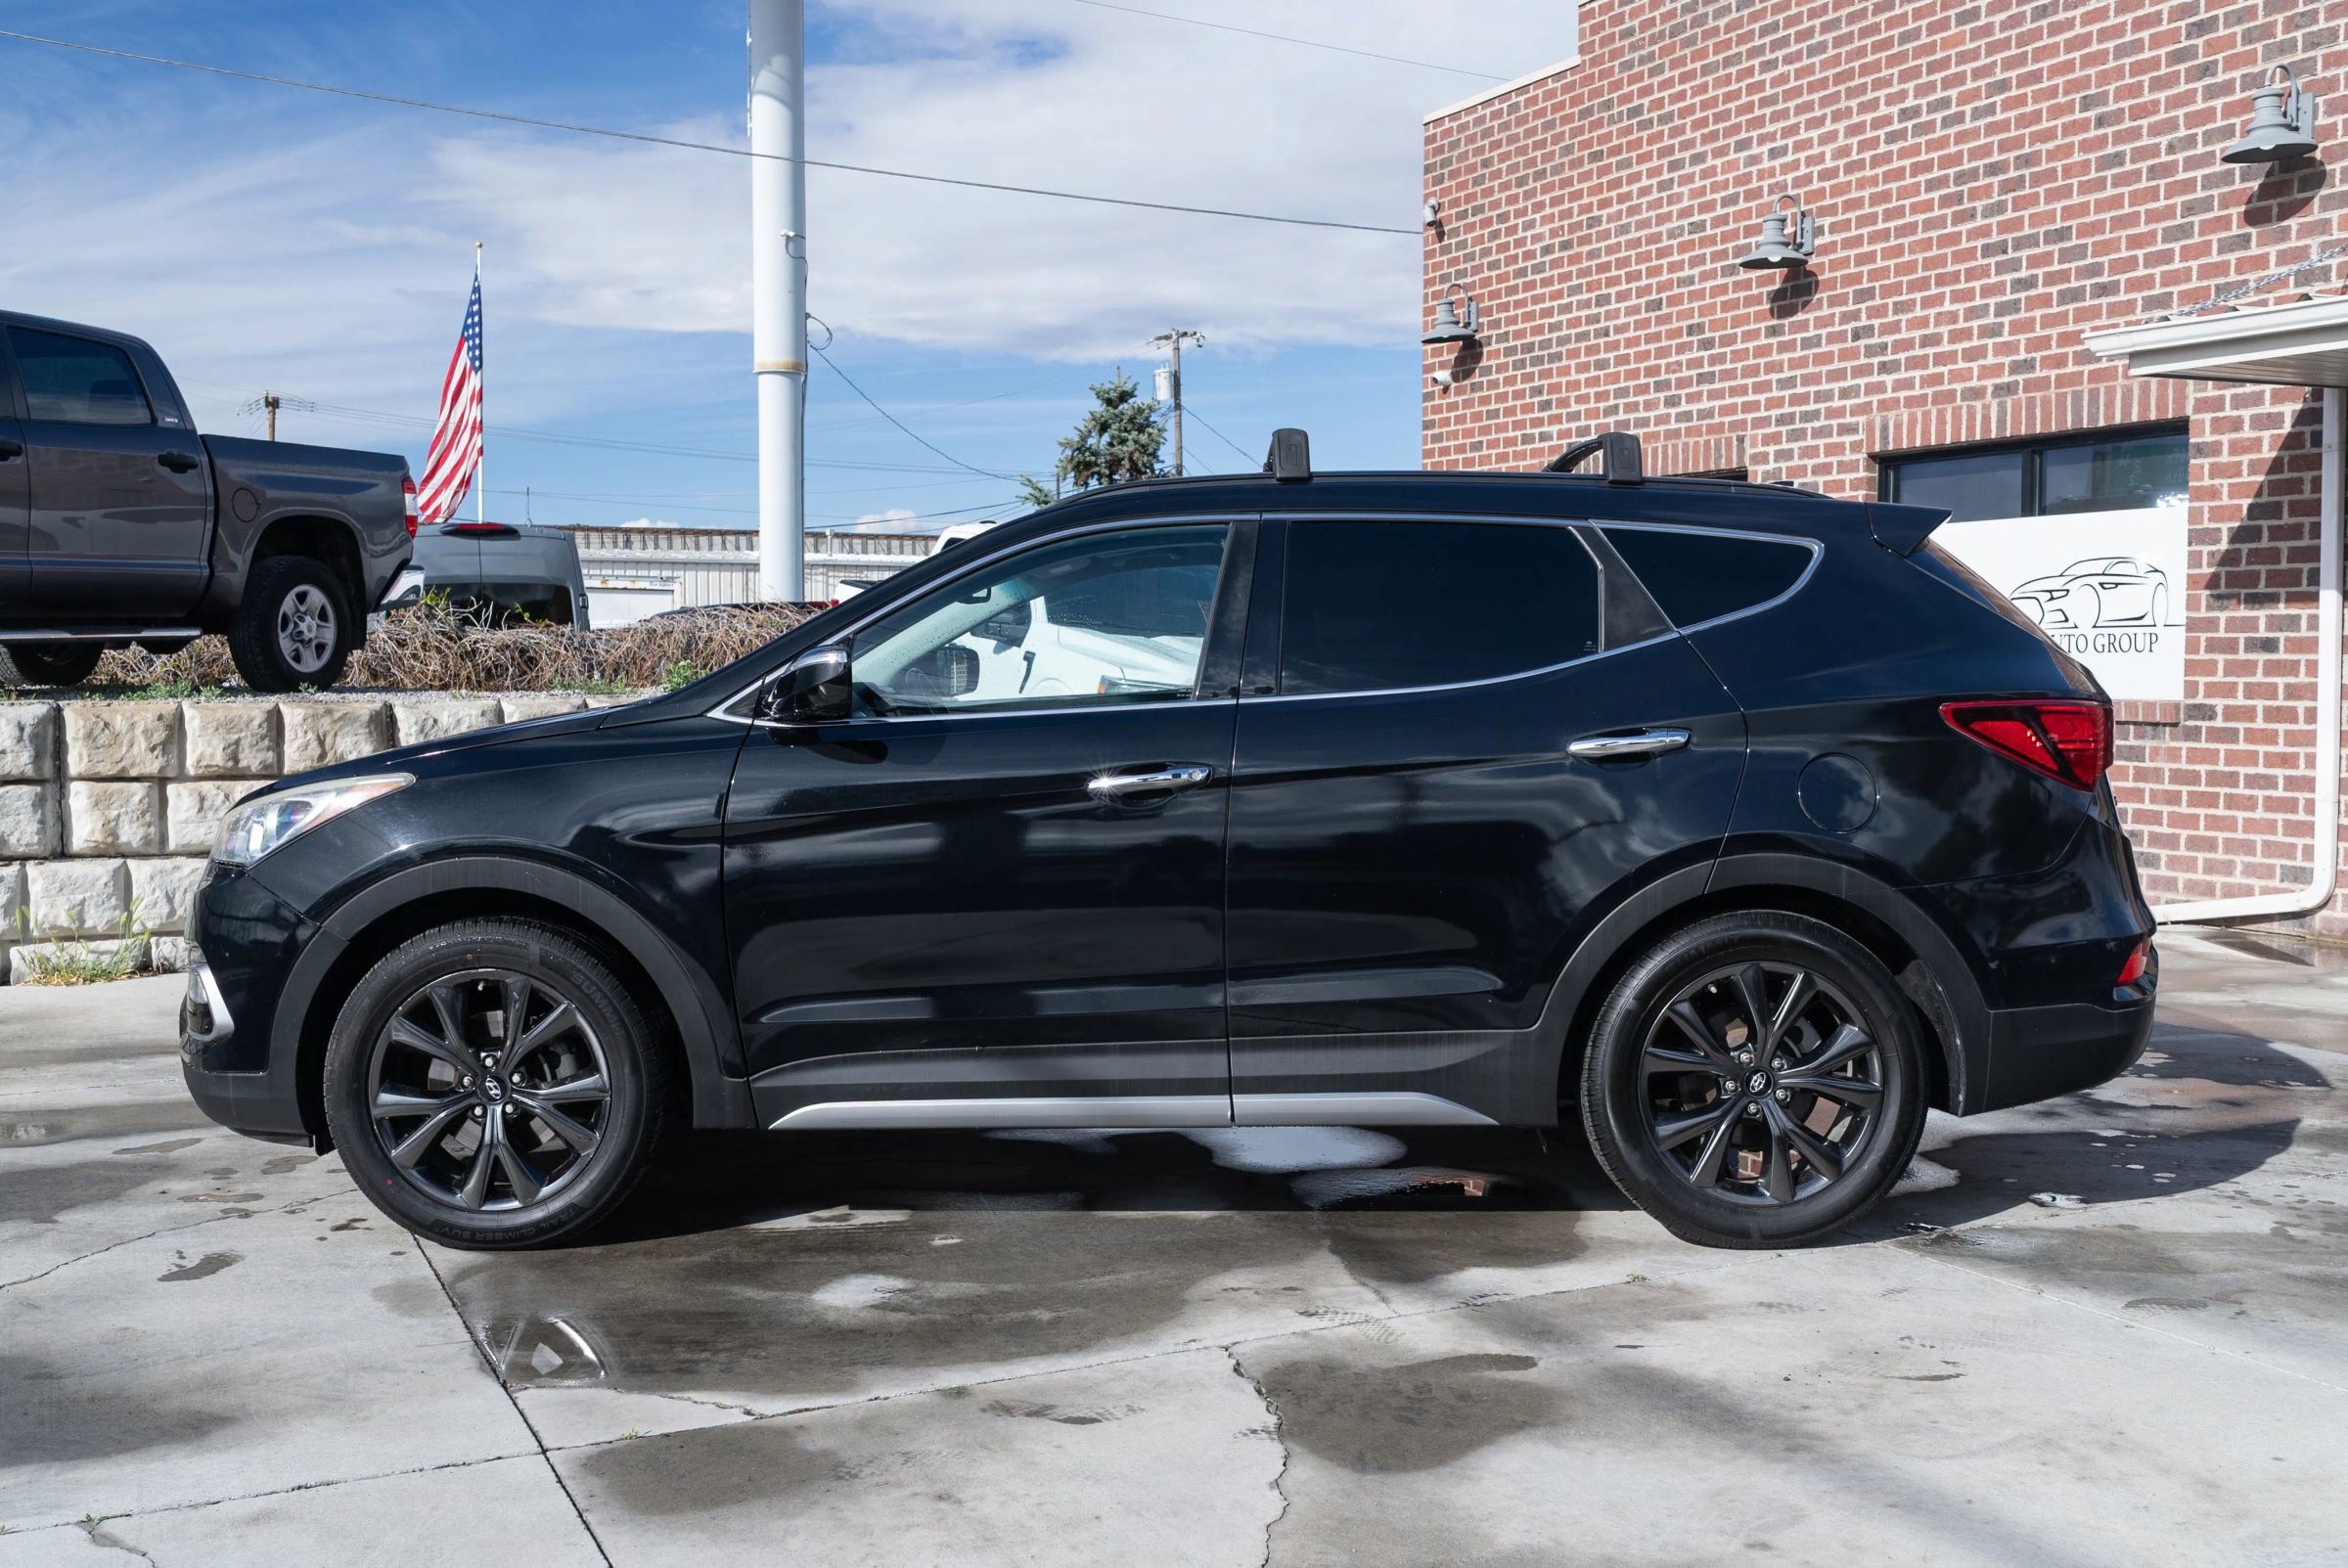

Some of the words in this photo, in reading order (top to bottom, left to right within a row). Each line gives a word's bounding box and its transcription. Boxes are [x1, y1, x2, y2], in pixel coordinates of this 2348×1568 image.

[2094, 633, 2158, 653] GROUP
[540, 1208, 576, 1229] TRAIL
[475, 1228, 536, 1240] CLIMBER
